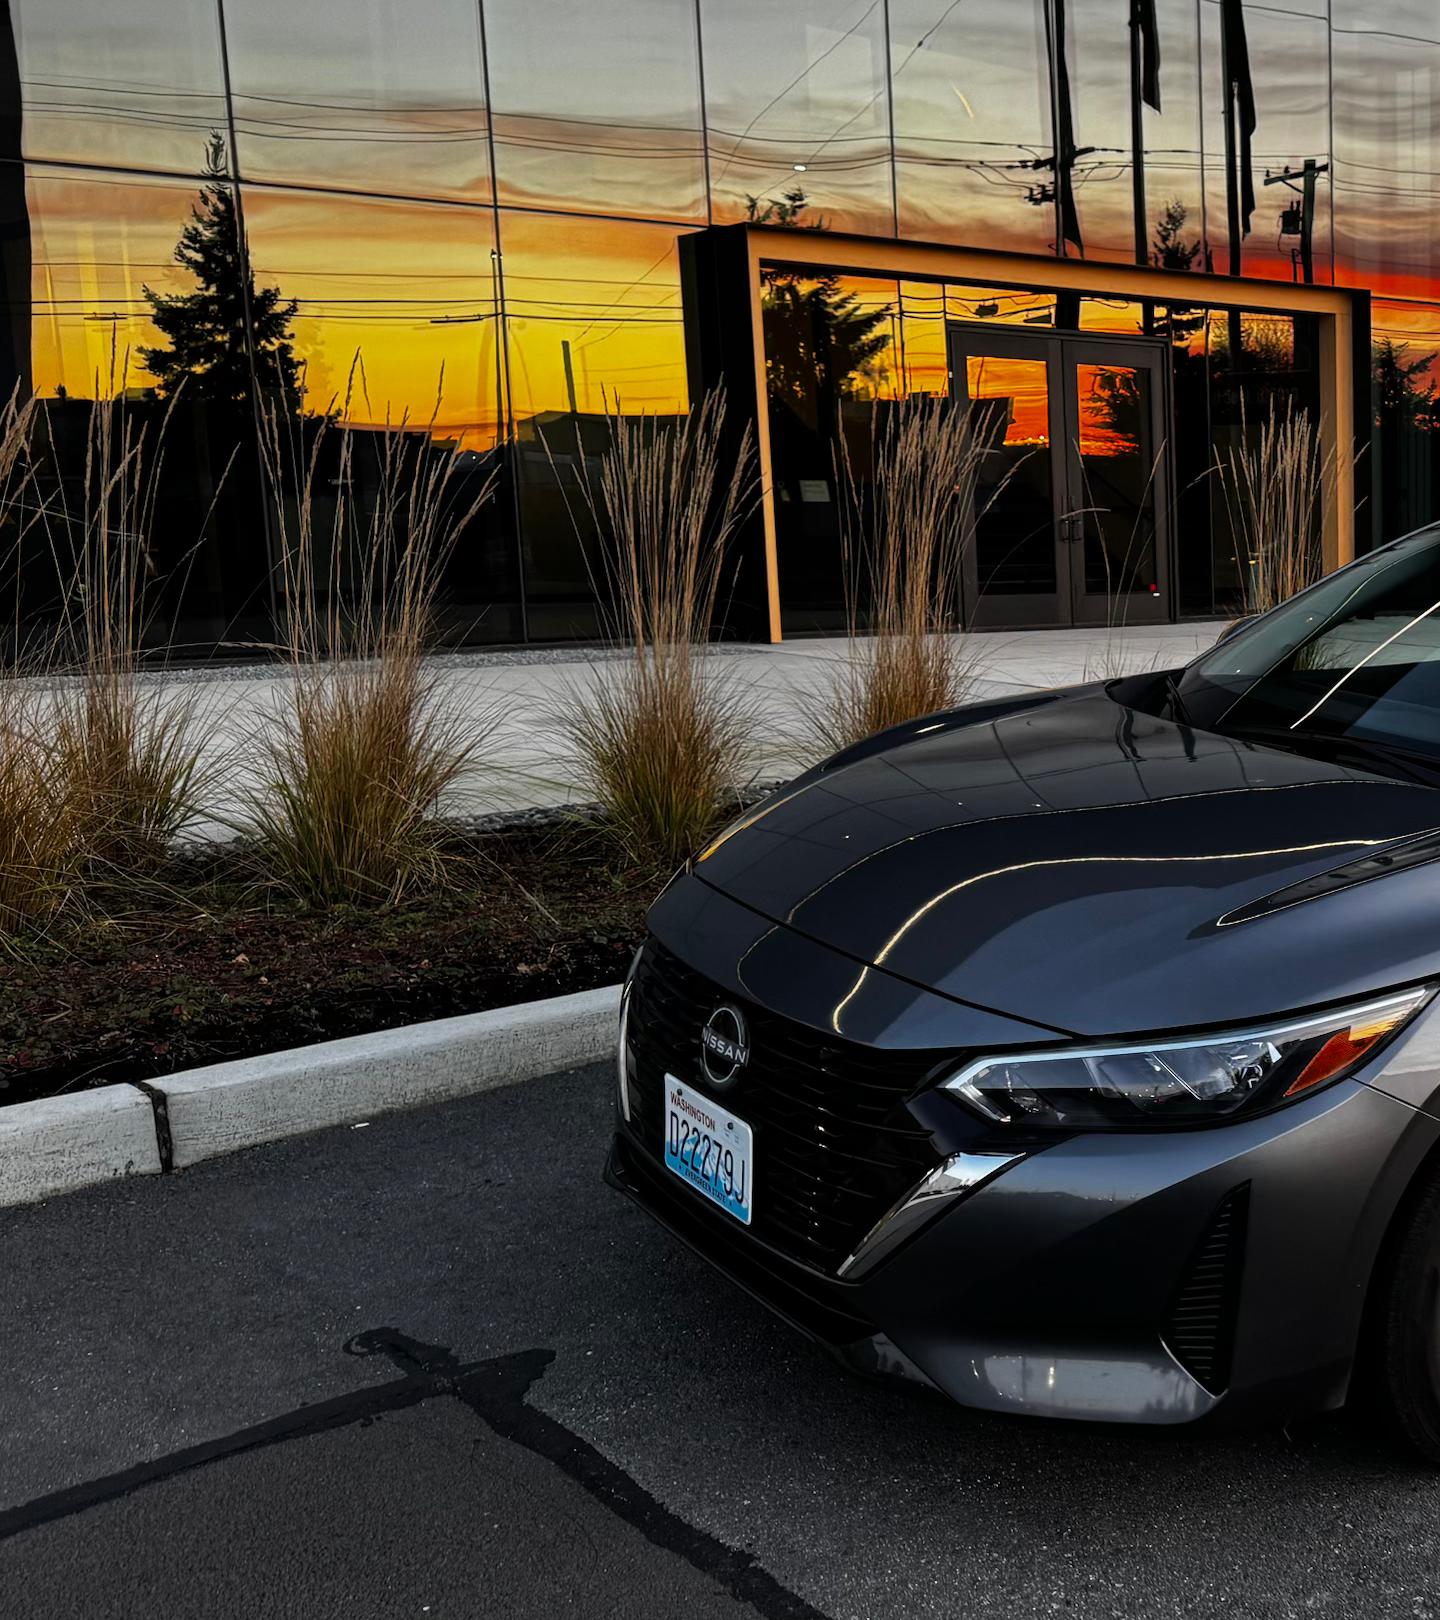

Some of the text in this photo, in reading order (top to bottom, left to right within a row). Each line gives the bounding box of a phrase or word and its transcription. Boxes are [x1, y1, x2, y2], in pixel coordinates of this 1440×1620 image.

[703, 1027, 746, 1063] NISSAN
[670, 1090, 716, 1132] WASHINGTON
[670, 1110, 745, 1204] D22279J
